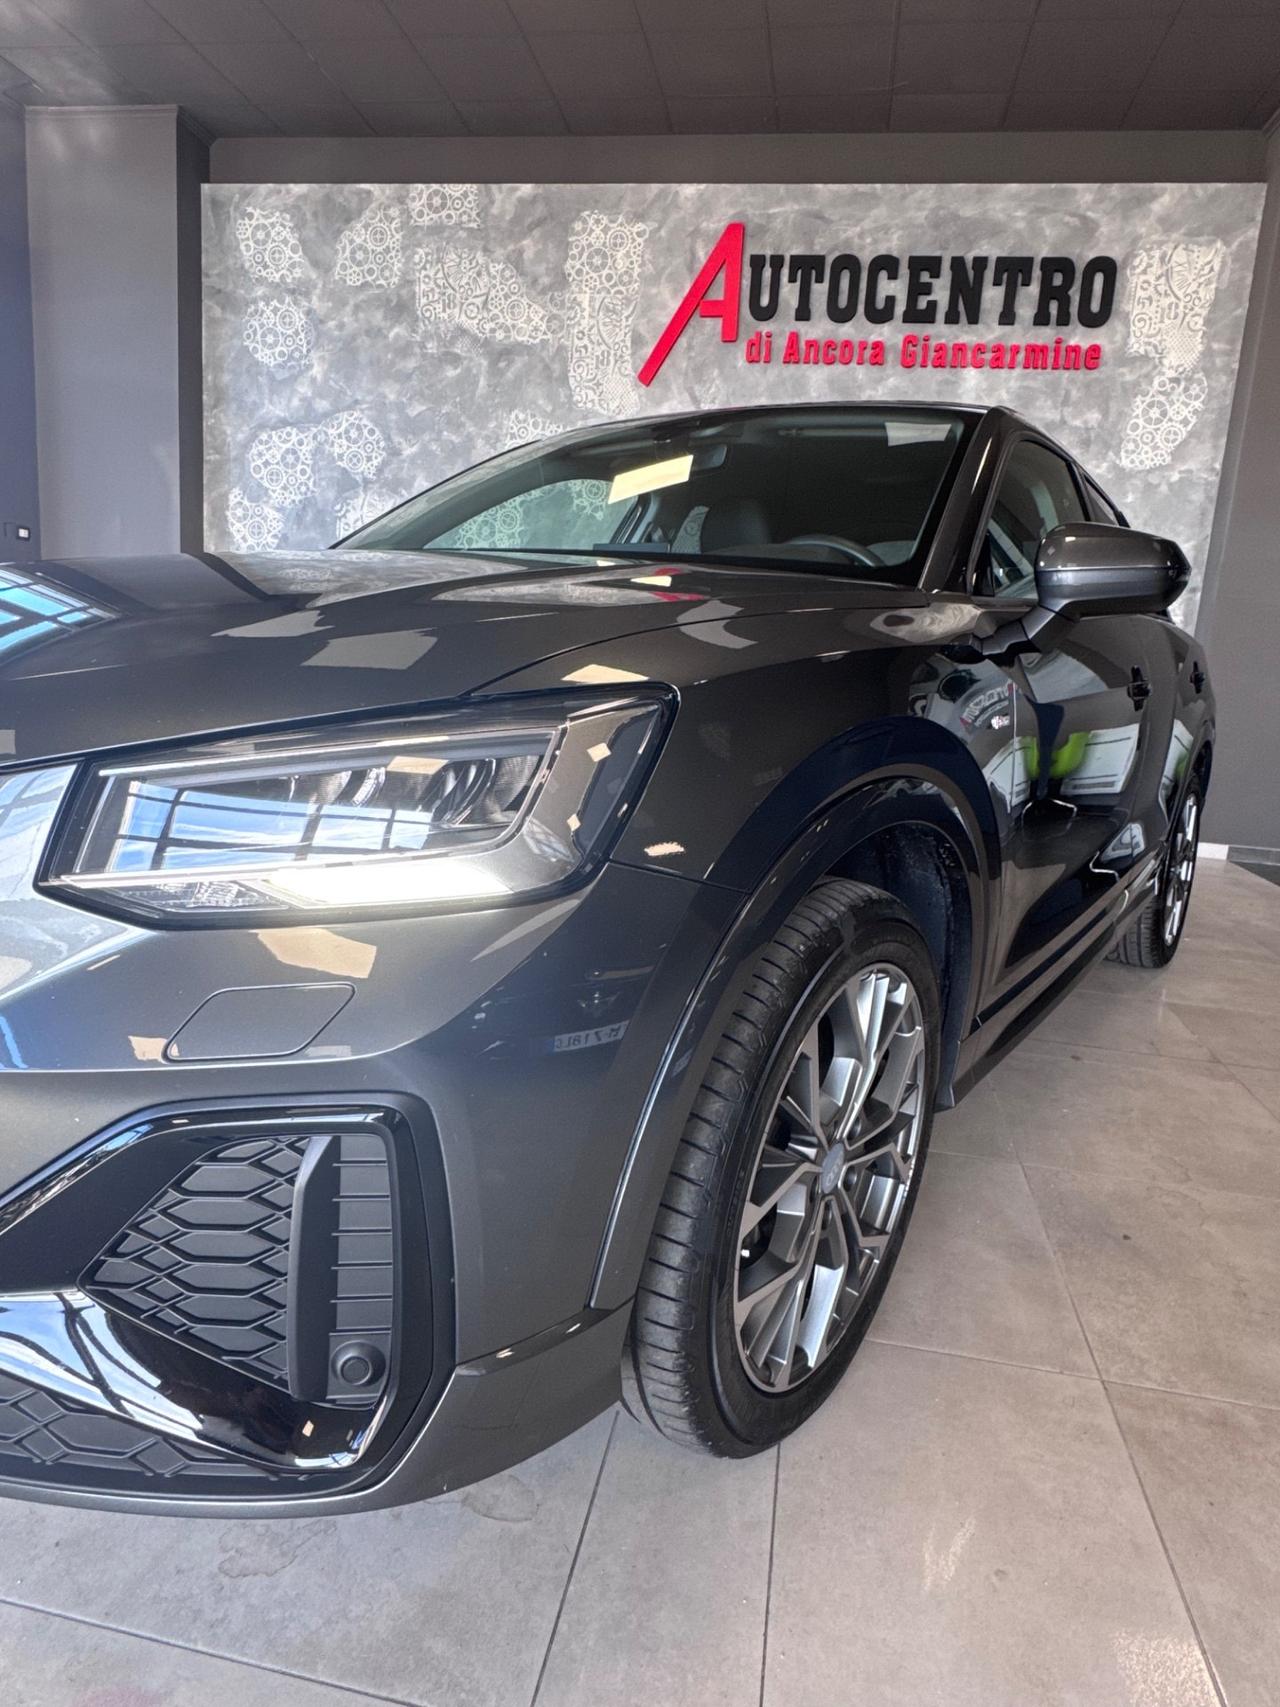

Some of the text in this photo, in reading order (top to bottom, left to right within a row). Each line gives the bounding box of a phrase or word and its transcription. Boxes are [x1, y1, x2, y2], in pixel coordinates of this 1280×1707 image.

[638, 222, 1118, 388] AUTOCENTRO
[746, 331, 1102, 371] di Ancora Giancarmine
